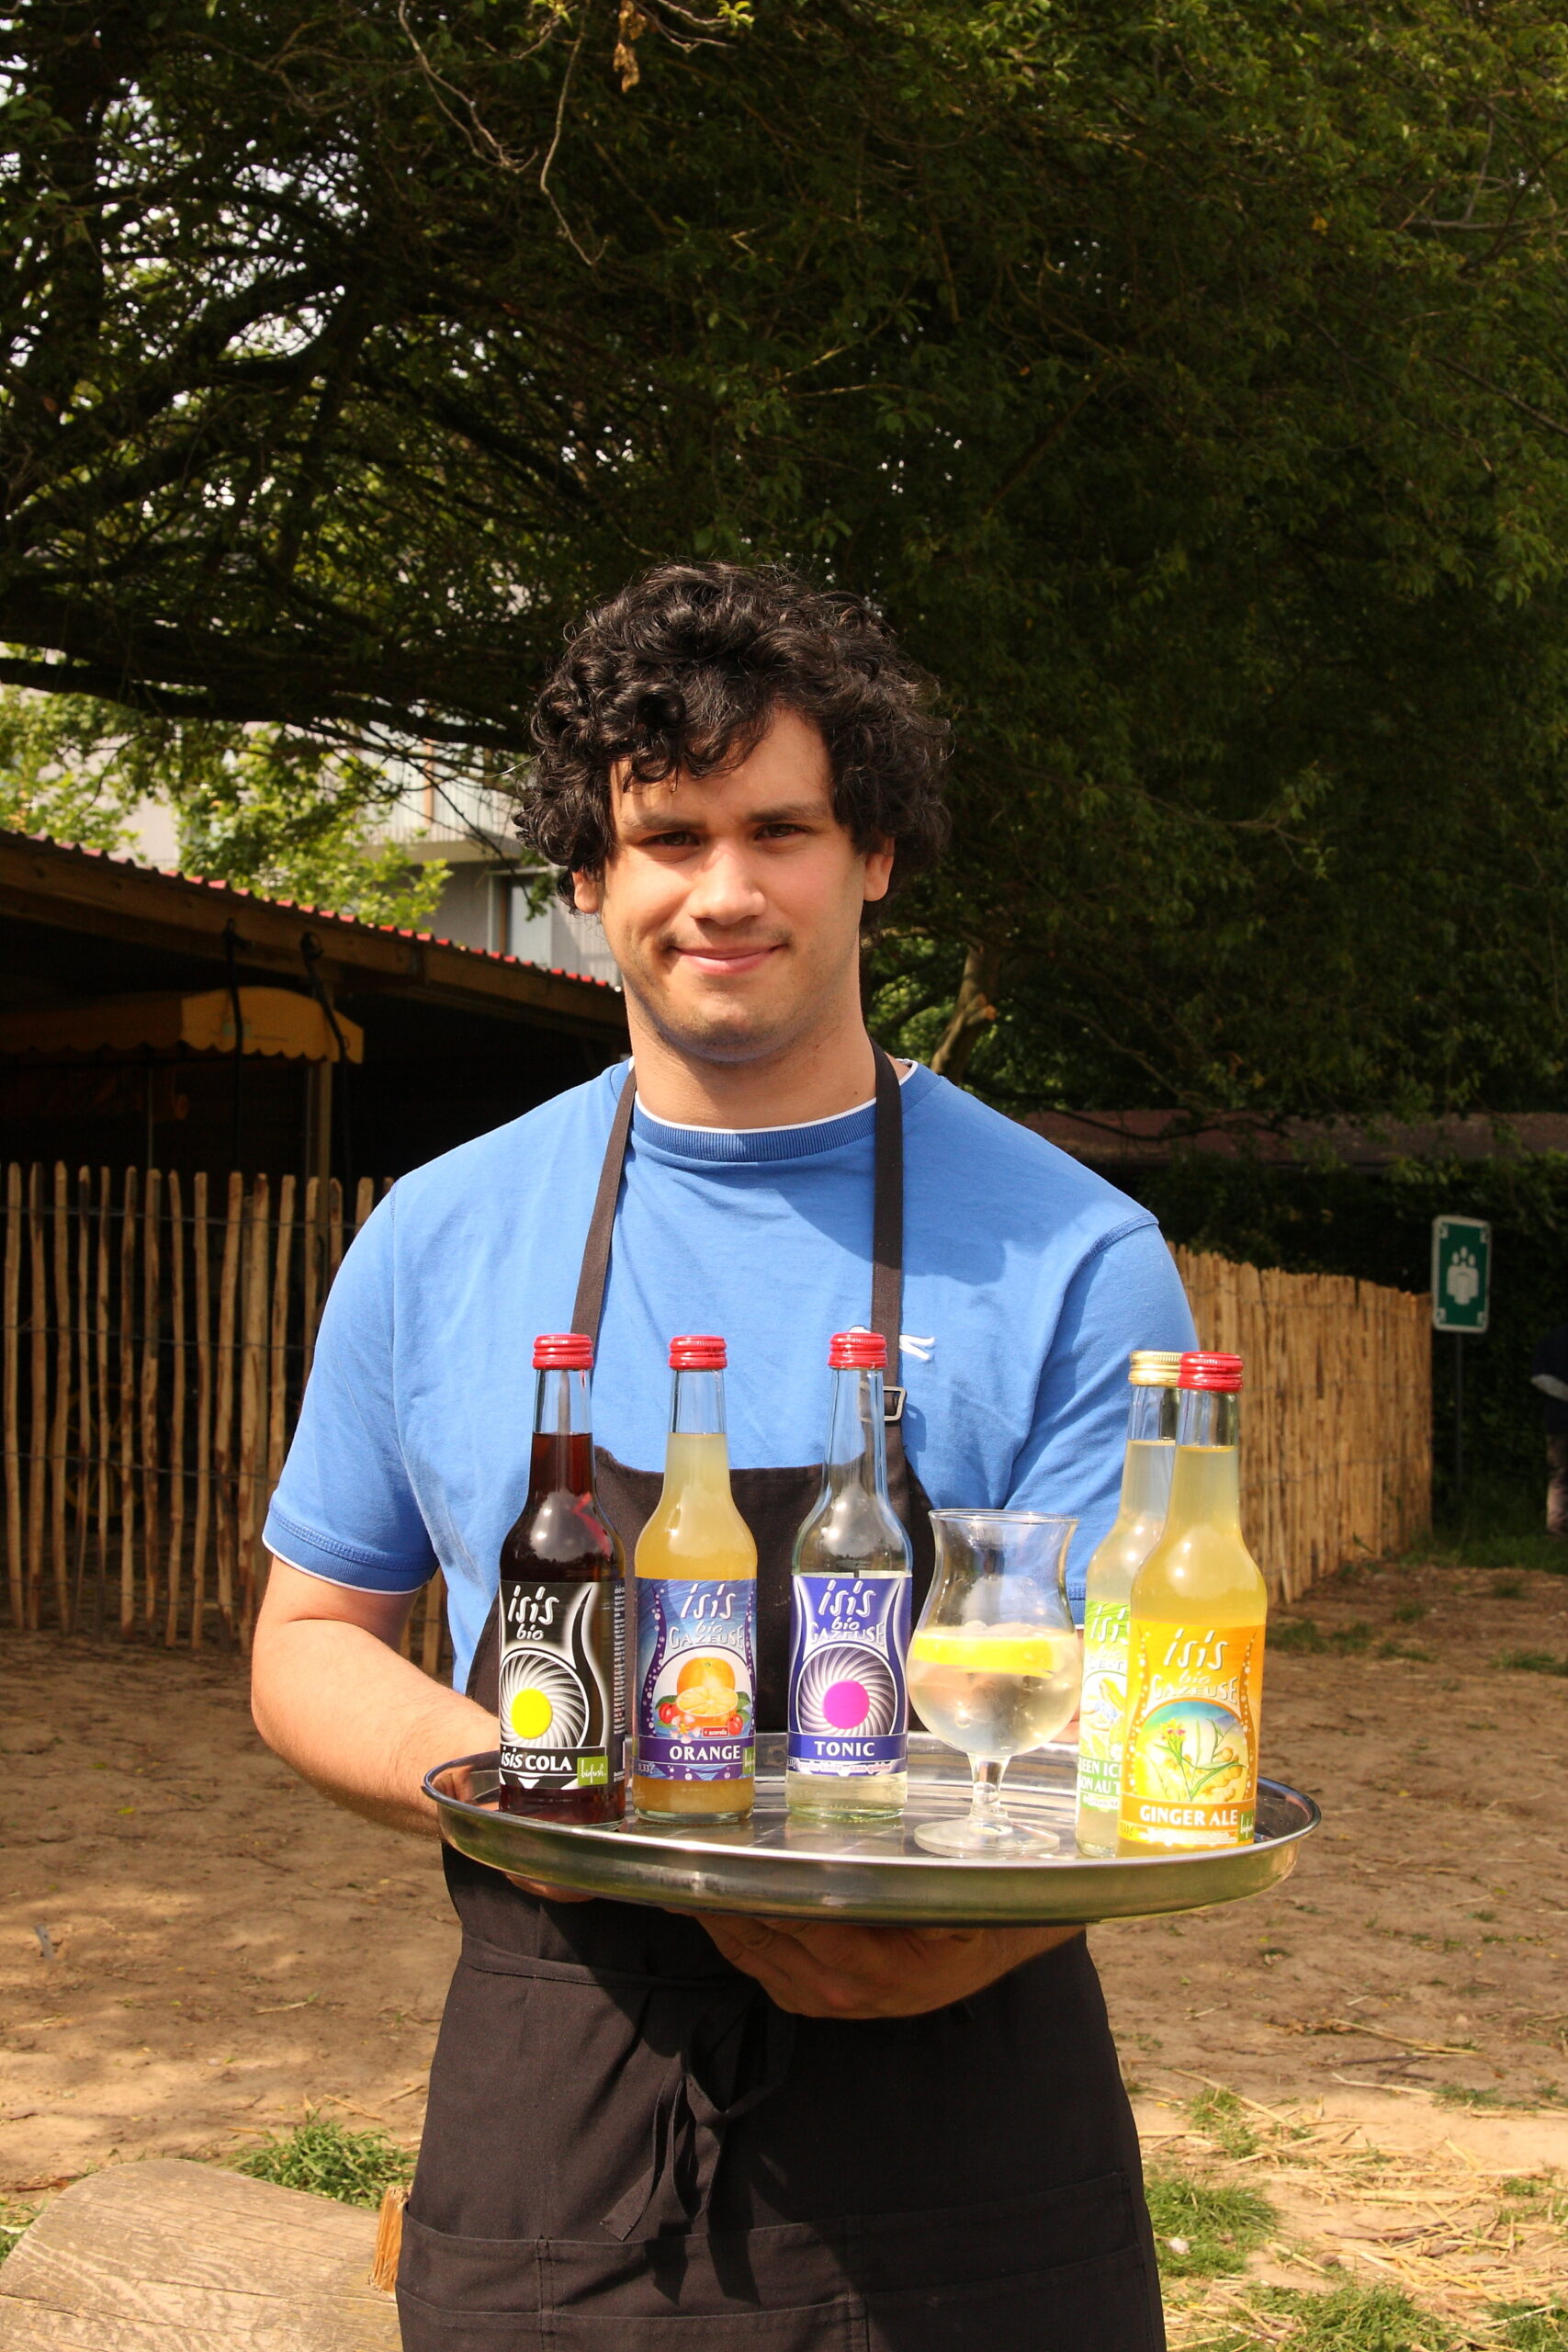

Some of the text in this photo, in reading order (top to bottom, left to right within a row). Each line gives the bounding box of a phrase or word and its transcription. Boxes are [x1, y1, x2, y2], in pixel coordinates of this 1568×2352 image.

[507, 1585, 559, 1625] isis
[681, 1583, 736, 1620] isis
[818, 1579, 876, 1617] isis
[516, 1623, 544, 1641] bio
[695, 1620, 723, 1634] bio
[810, 1622, 884, 1646] GAZEUSE
[831, 1616, 860, 1631] bio
[669, 1624, 743, 1649] GAZEUSE
[1163, 1628, 1229, 1670] isis
[1150, 1674, 1238, 1704] GAZEUSE
[1179, 1669, 1211, 1685] bio
[501, 1747, 572, 1771] isis COLA
[669, 1745, 741, 1761] ORANGE
[814, 1740, 875, 1758] TONIC
[1139, 1804, 1239, 1826] GINGER ALE
